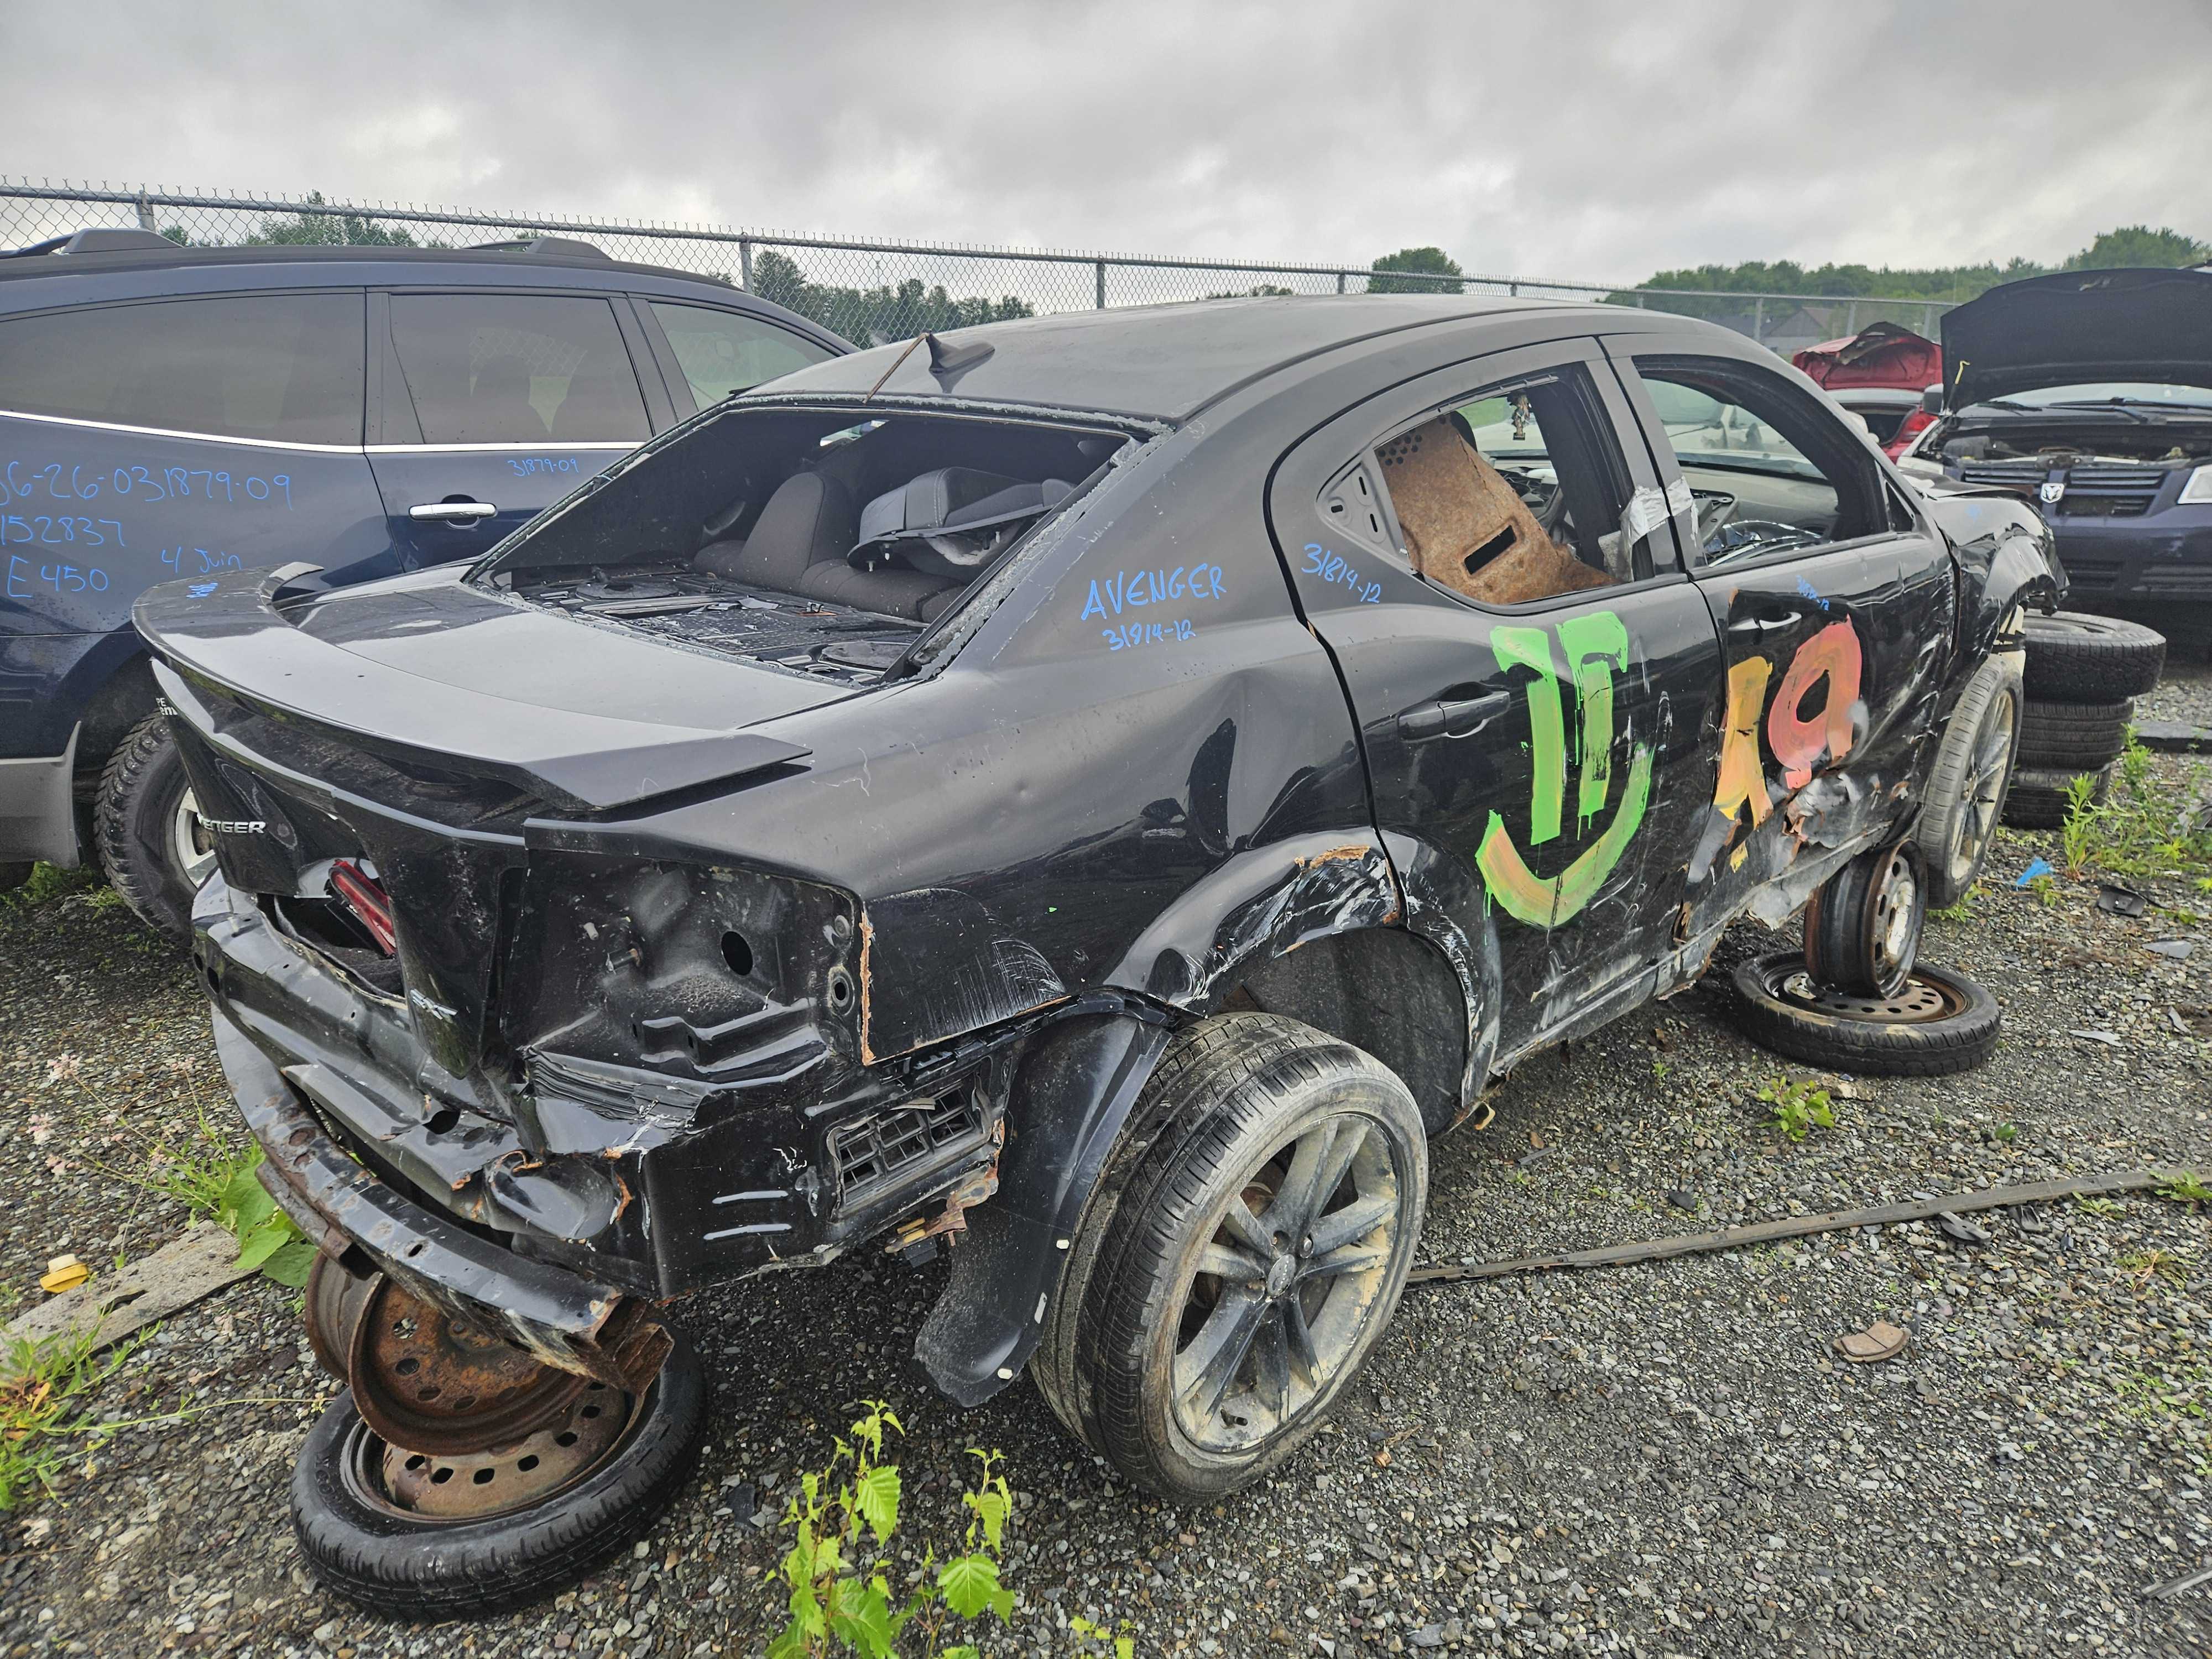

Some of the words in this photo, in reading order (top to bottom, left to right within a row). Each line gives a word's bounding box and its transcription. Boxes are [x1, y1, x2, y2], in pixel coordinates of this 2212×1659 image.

[507, 458, 579, 477] 31879-09
[7, 555, 32, 598] E
[40, 565, 109, 592] 450
[161, 546, 182, 573] 4
[1081, 563, 1228, 621] AVENGER
